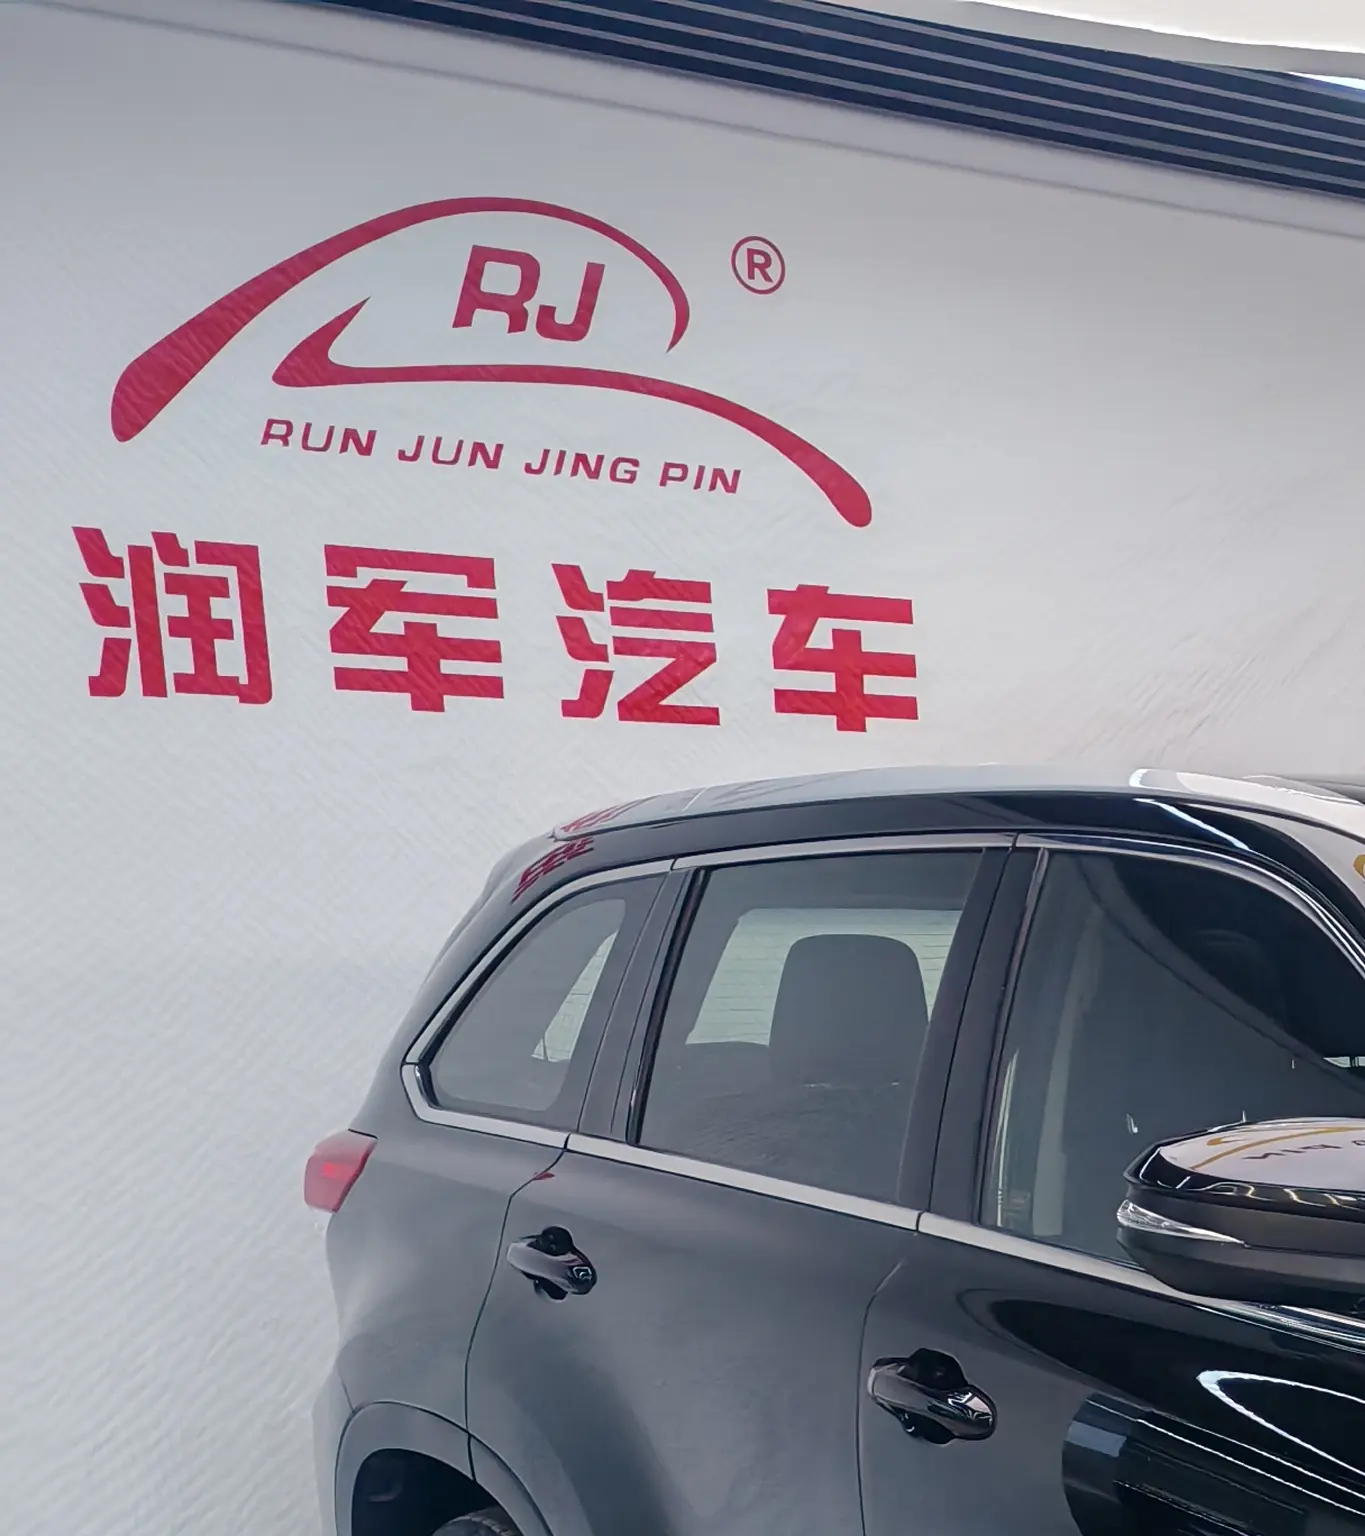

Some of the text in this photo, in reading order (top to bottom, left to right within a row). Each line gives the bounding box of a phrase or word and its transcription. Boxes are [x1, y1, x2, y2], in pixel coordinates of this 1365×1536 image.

[452, 244, 605, 341] RJ
[260, 418, 741, 493] RUN JUN JING PIN
[72, 526, 919, 732] 润军汽车
